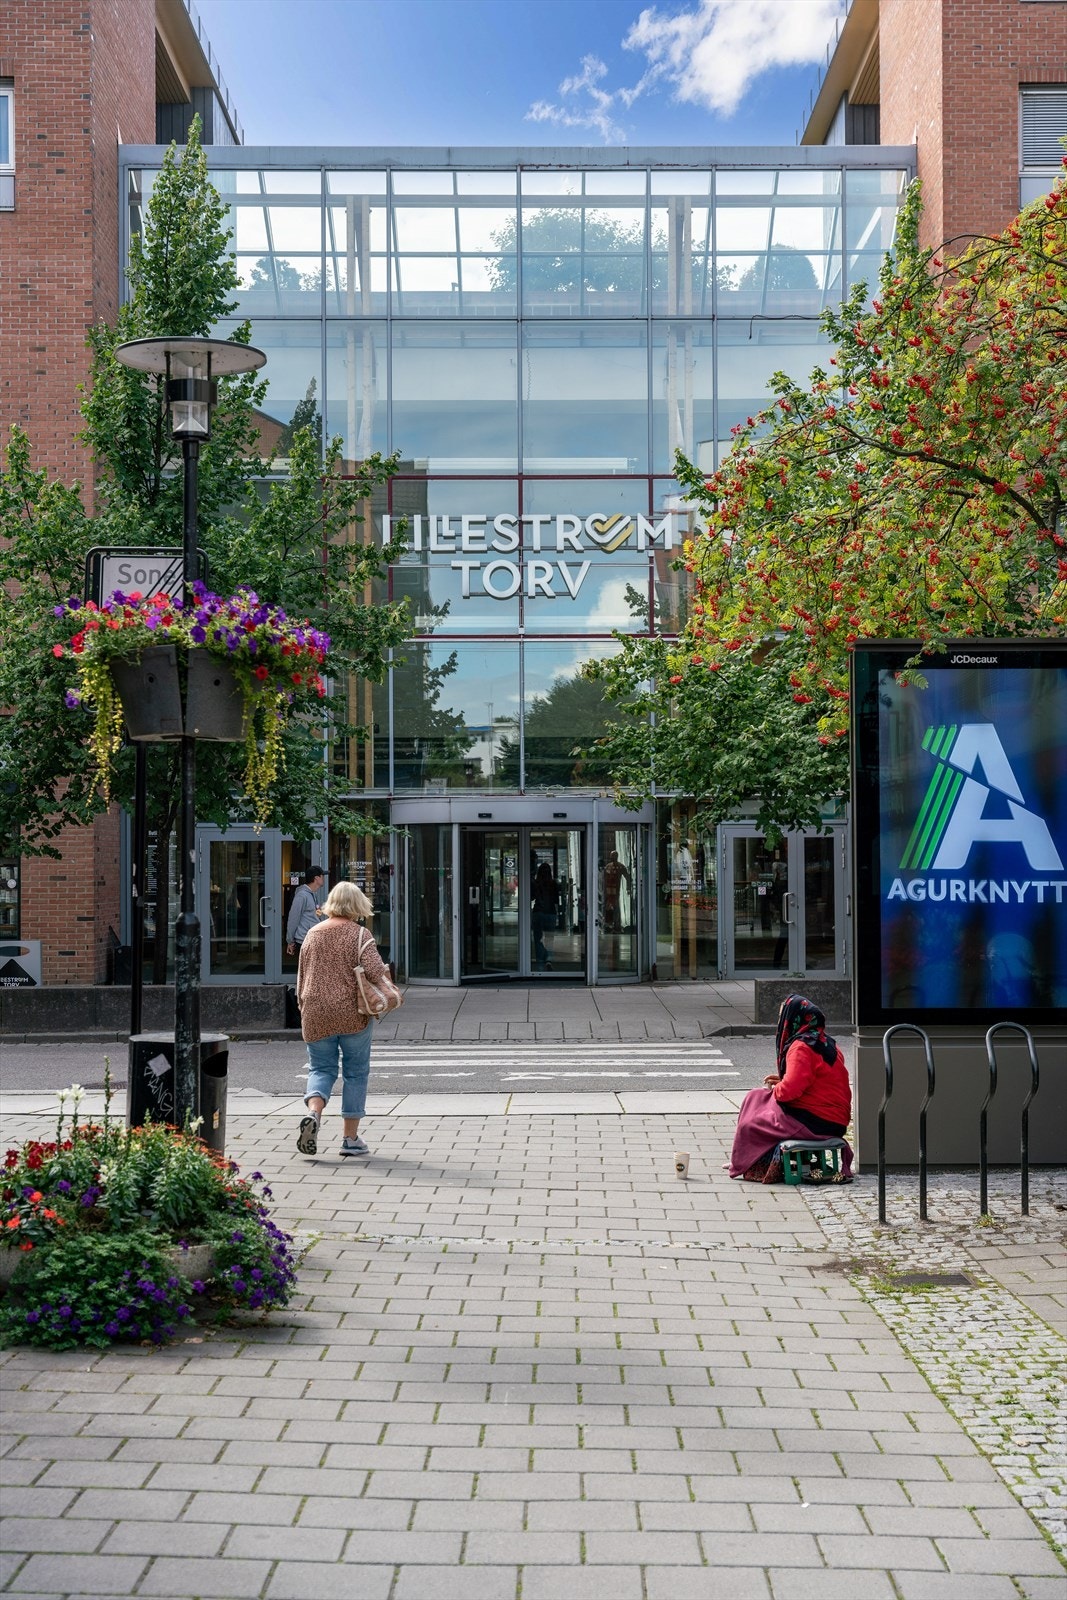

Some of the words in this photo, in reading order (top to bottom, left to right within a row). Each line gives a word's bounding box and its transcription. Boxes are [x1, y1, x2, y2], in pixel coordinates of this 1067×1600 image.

[117, 563, 176, 585] Sone
[451, 559, 592, 600] TORV
[950, 654, 998, 665] JCDecaux
[887, 878, 1067, 904] AGURKNYTT
